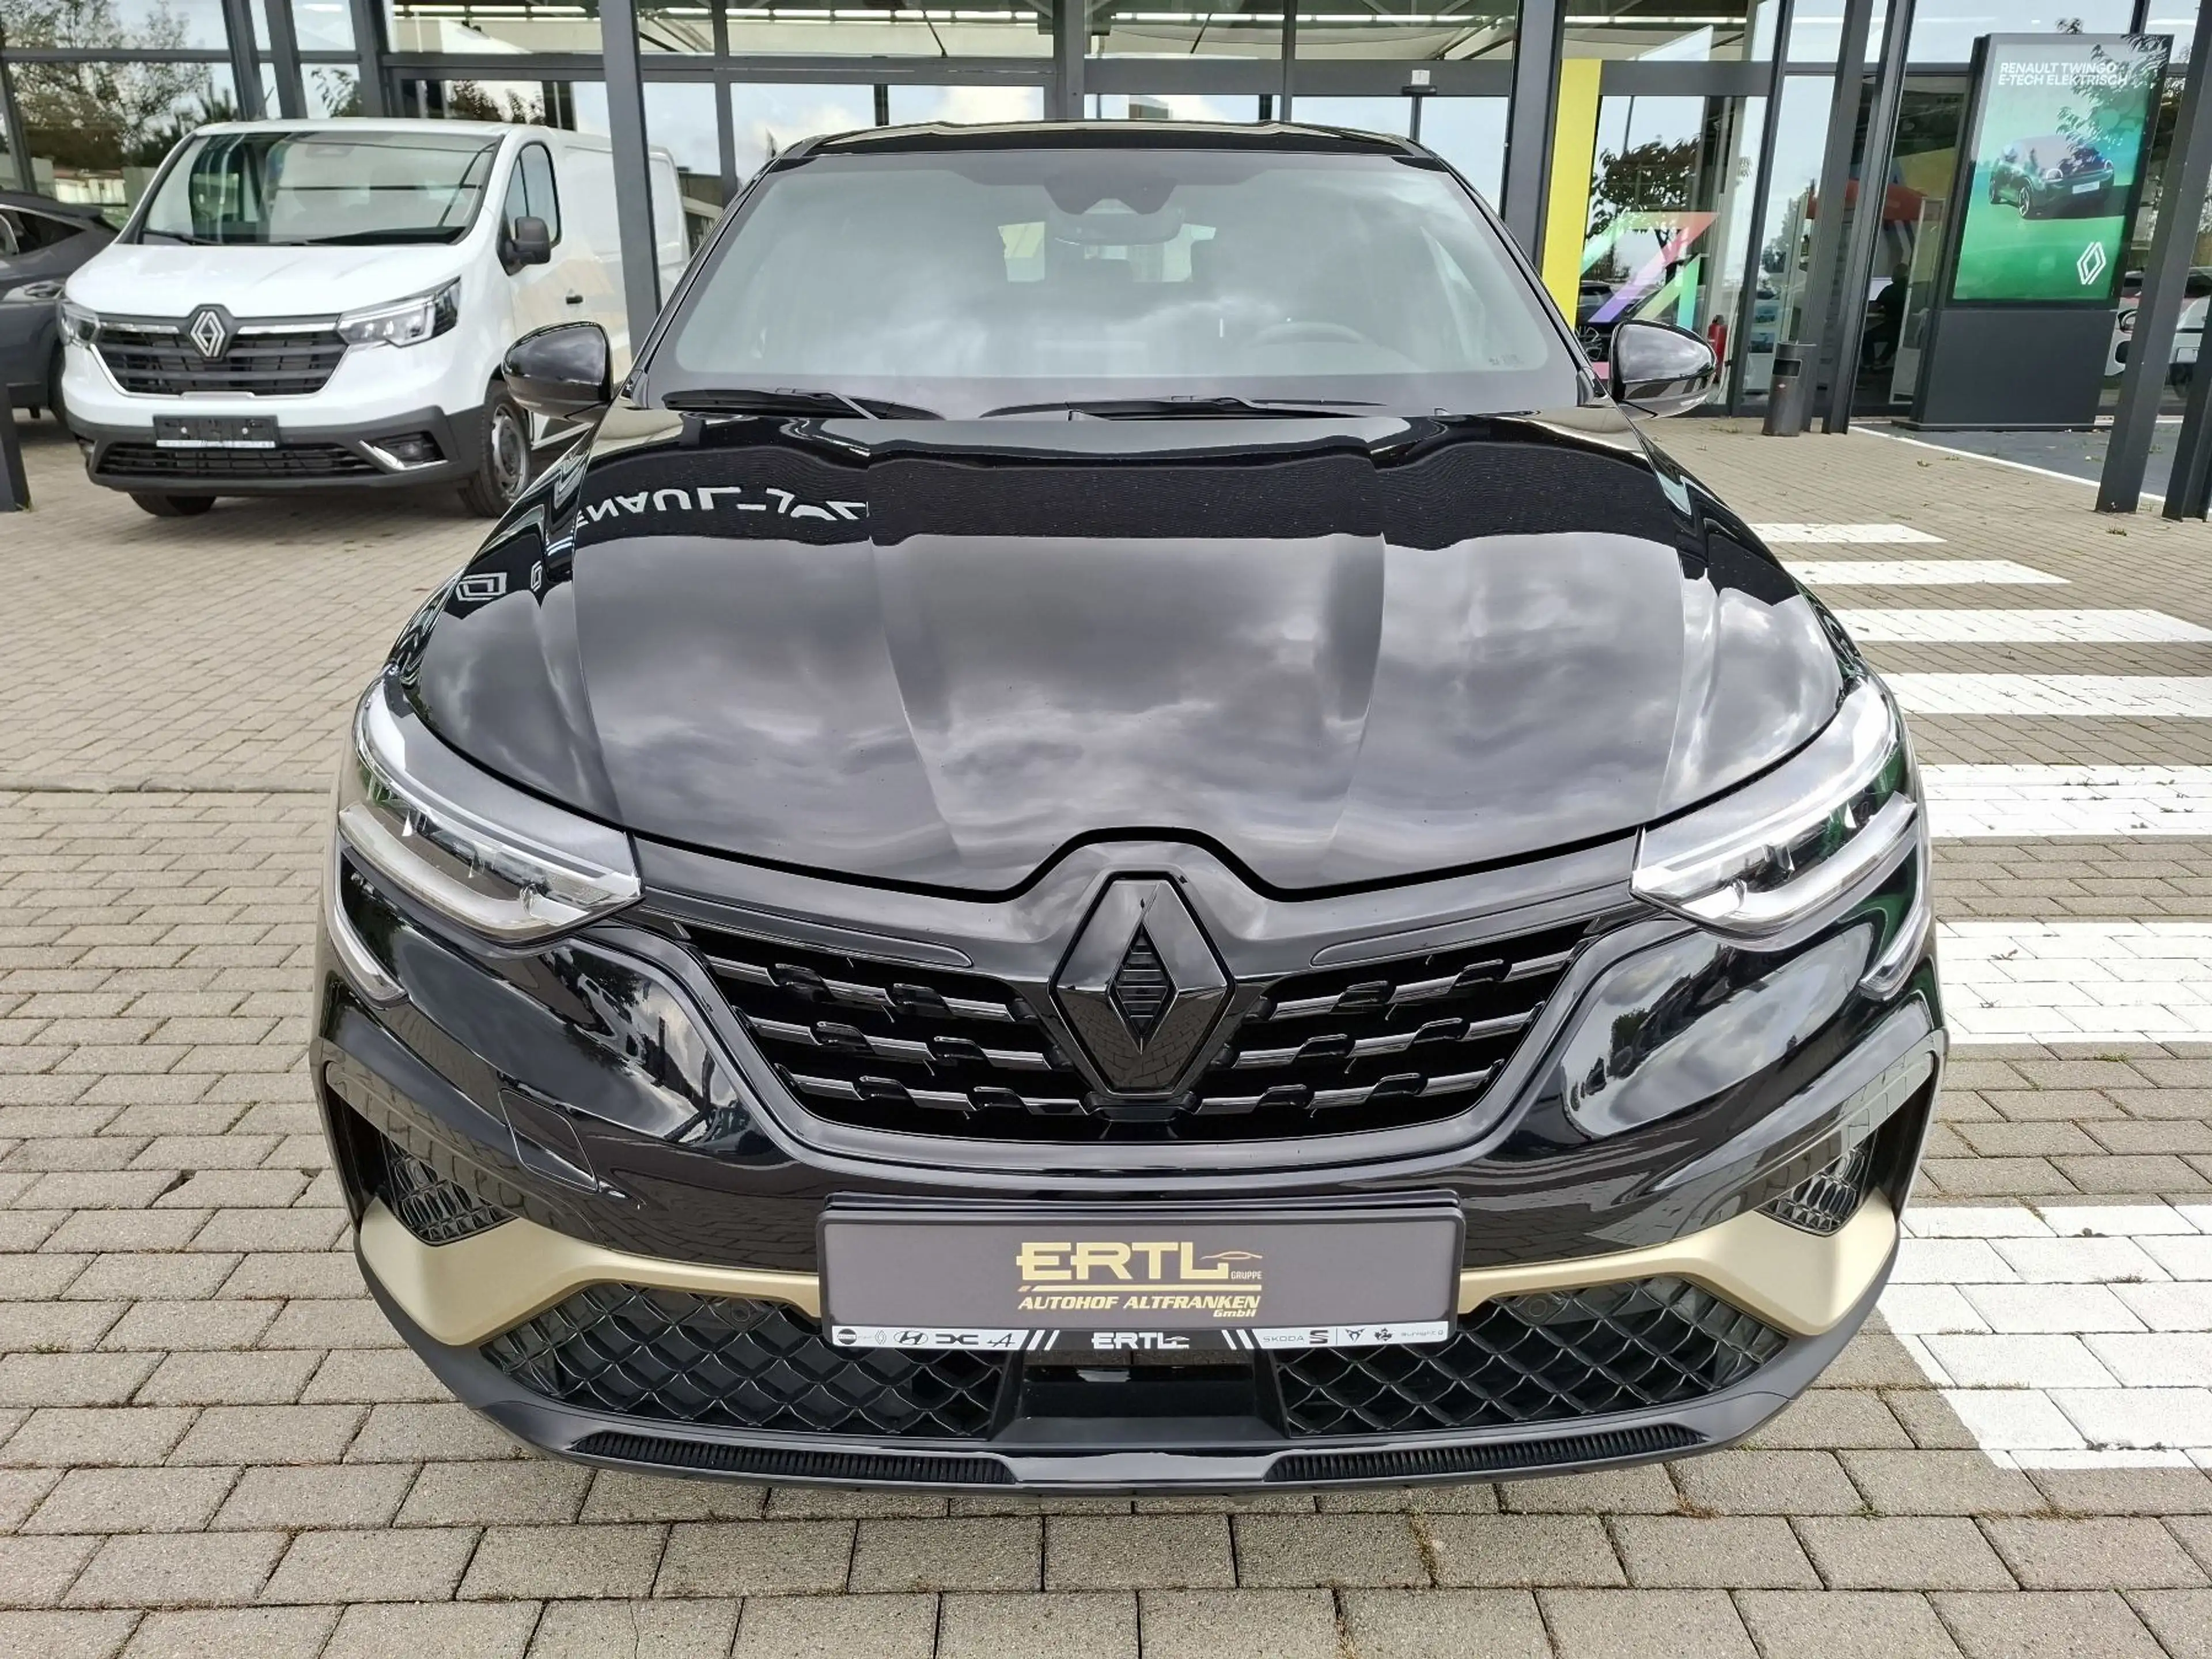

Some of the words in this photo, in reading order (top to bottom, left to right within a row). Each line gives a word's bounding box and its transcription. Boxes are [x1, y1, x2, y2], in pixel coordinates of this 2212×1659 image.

[2000, 62, 2059, 74] RENAULT
[2061, 62, 2118, 74] TWINGO
[1998, 74, 2044, 85] E-TECH
[2046, 74, 2130, 86] ELEKTRISCH
[1016, 1242, 1229, 1281] ERTL
[1230, 1270, 1263, 1279] GRUPPE
[1017, 1296, 1119, 1310] AUTOHOF
[1123, 1295, 1261, 1309] ALTFRANKEN
[1213, 1308, 1257, 1318] GmbH
[1091, 1332, 1177, 1349] ERTL
